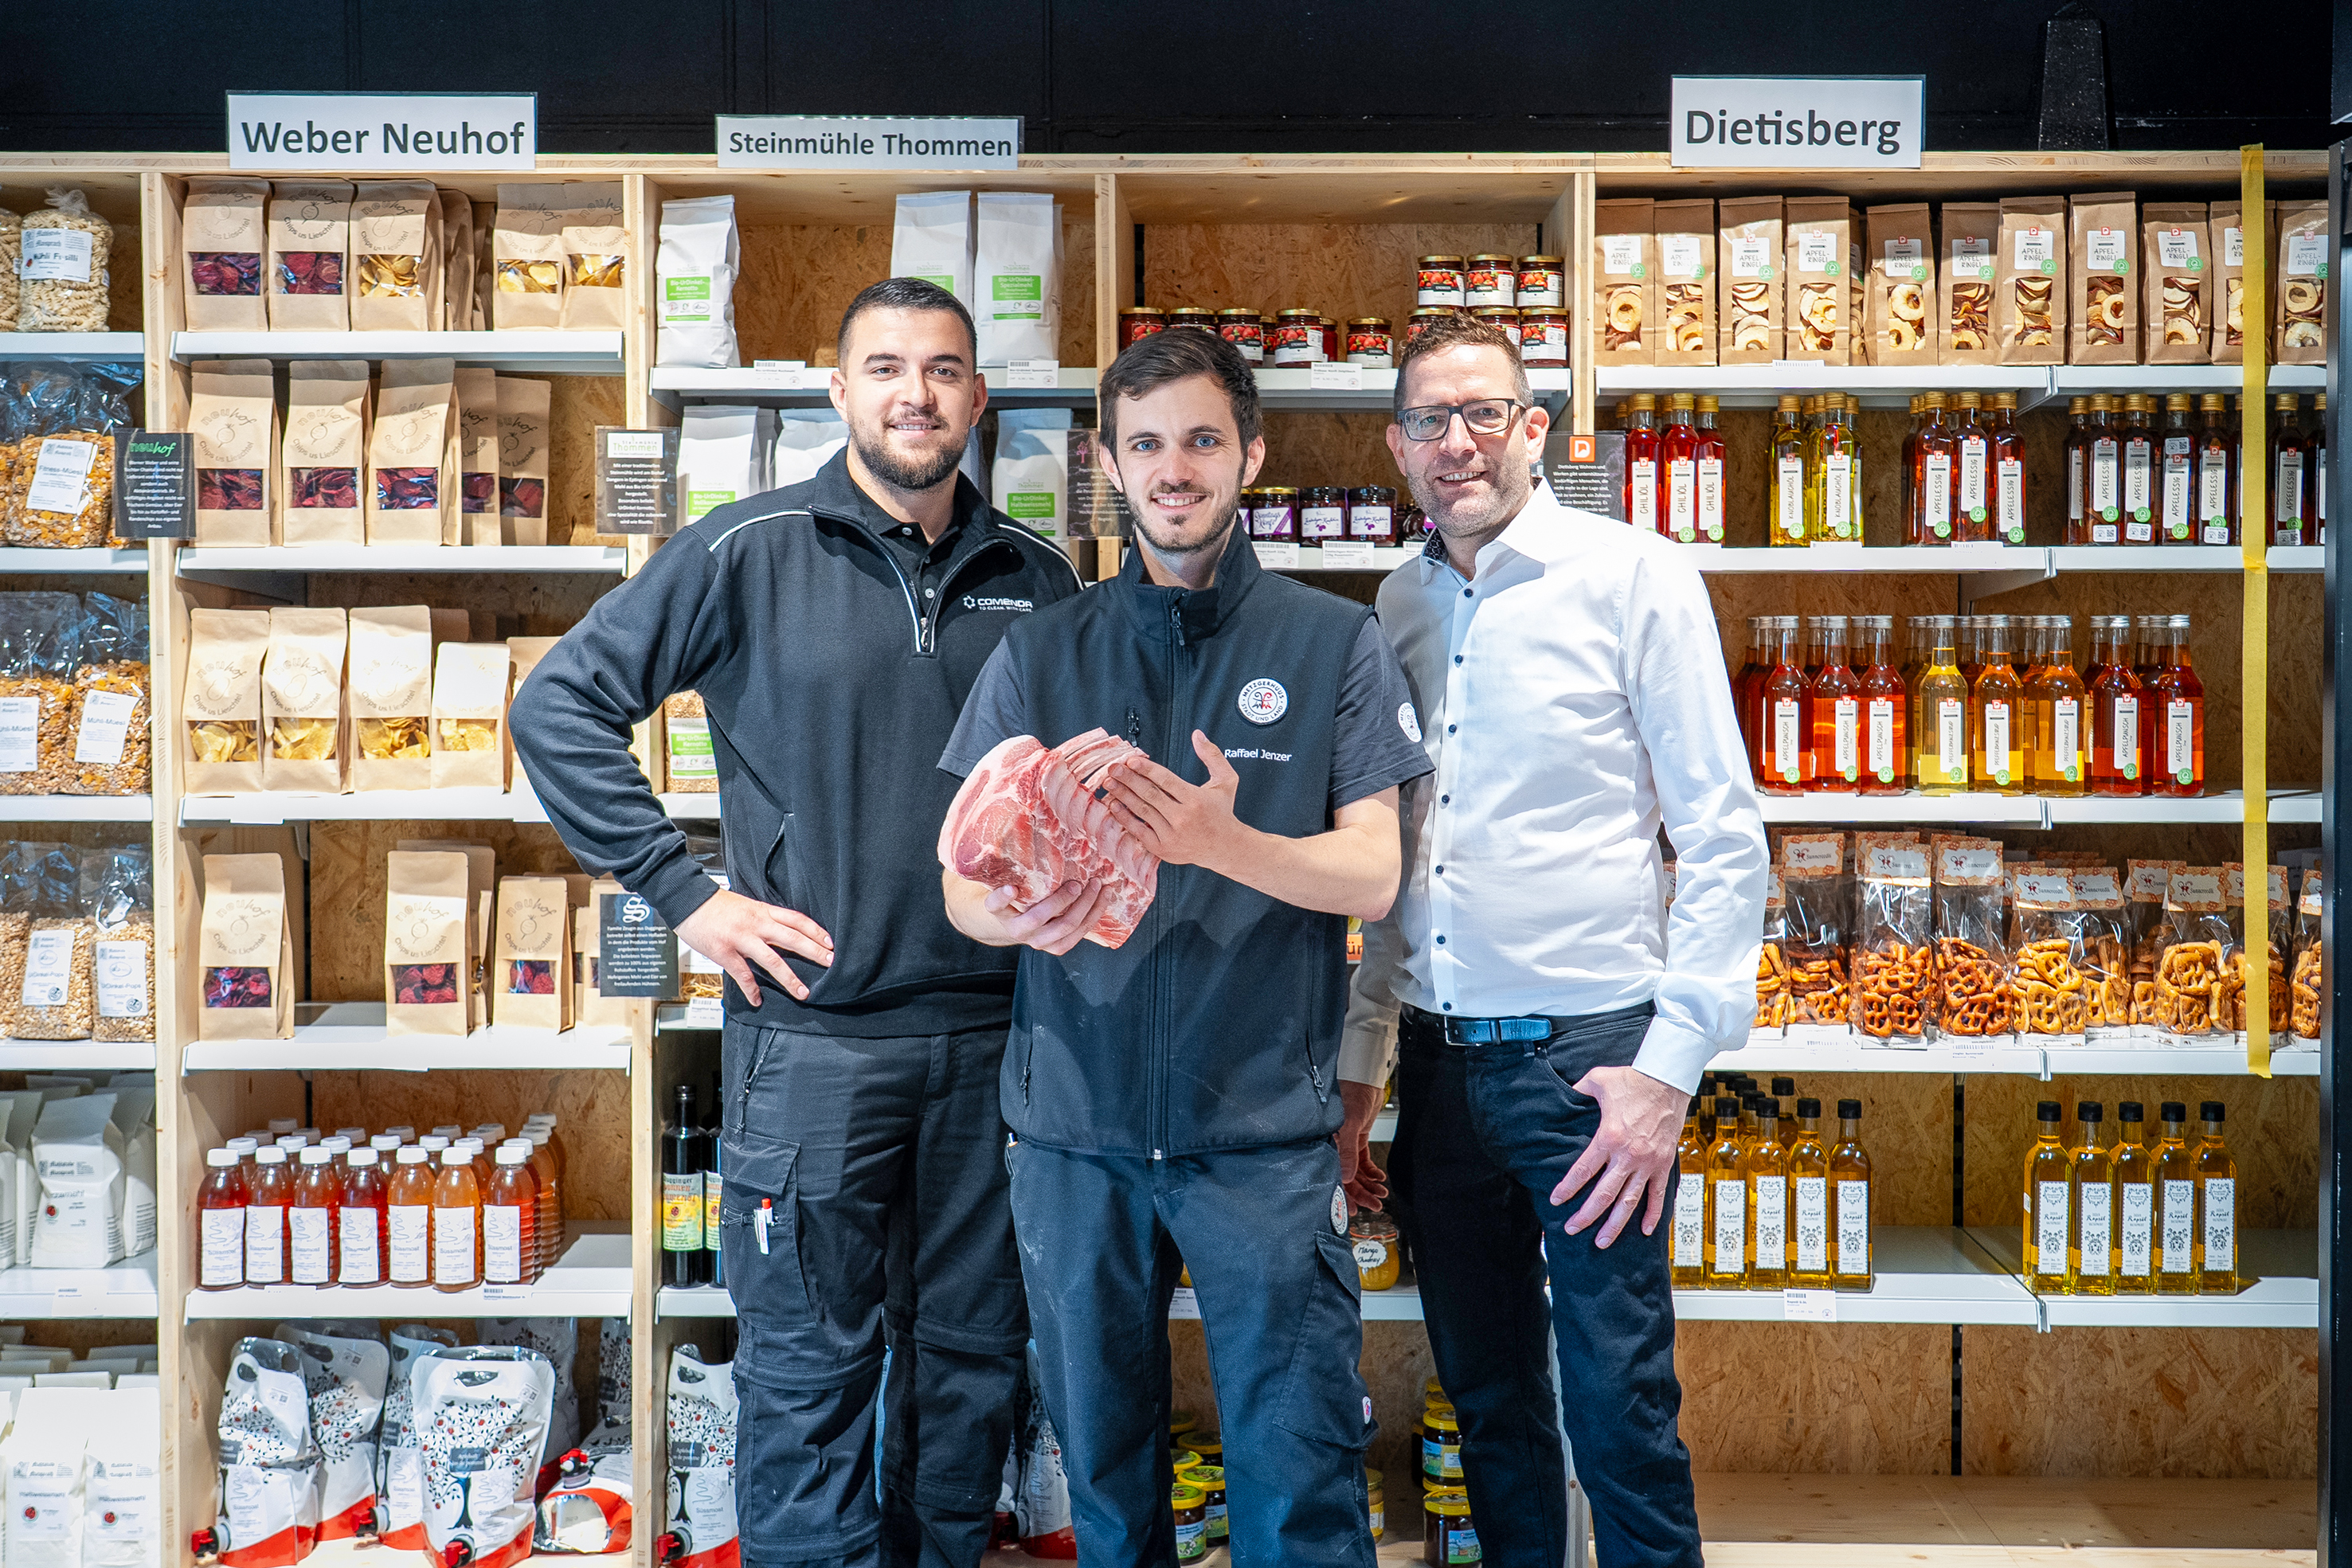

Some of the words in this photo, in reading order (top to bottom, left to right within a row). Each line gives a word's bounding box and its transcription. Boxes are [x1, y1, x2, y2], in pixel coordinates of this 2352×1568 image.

[241, 120, 369, 153] Weber
[383, 121, 525, 154] Neuhof
[729, 131, 874, 154] Steinmühle
[882, 133, 1012, 156] Thommen
[1686, 109, 1901, 155] Dietisberg
[130, 441, 177, 457] neuhof
[613, 443, 658, 452] Thommen
[1970, 459, 1978, 499] APFELESSIG
[2102, 459, 2111, 499] APFELESSIG
[2134, 459, 2143, 501] APFELESSIG
[1638, 484, 1649, 514] CHILIÖL
[1676, 483, 1687, 514] CHILIÖL
[1704, 482, 1715, 511] CHILIÖL
[1833, 473, 1842, 518] KNOBLAUCHÖL
[1934, 473, 1943, 514] APFELESSIG
[2171, 476, 2181, 517] APFELESSIG
[1242, 680, 1285, 700] METZGERHUUS
[1241, 703, 1254, 719] STADT
[1270, 705, 1284, 721] LAND
[1224, 748, 1258, 758] Raffael
[1260, 749, 1293, 762] Jenzer
[1679, 1206, 1699, 1214] Rapsöl
[1801, 1210, 1822, 1218] Rapsöl
[1842, 1212, 1864, 1222] Rapsöl
[2044, 1214, 2064, 1222] Rapsöl
[1357, 1246, 1380, 1258] Mango
